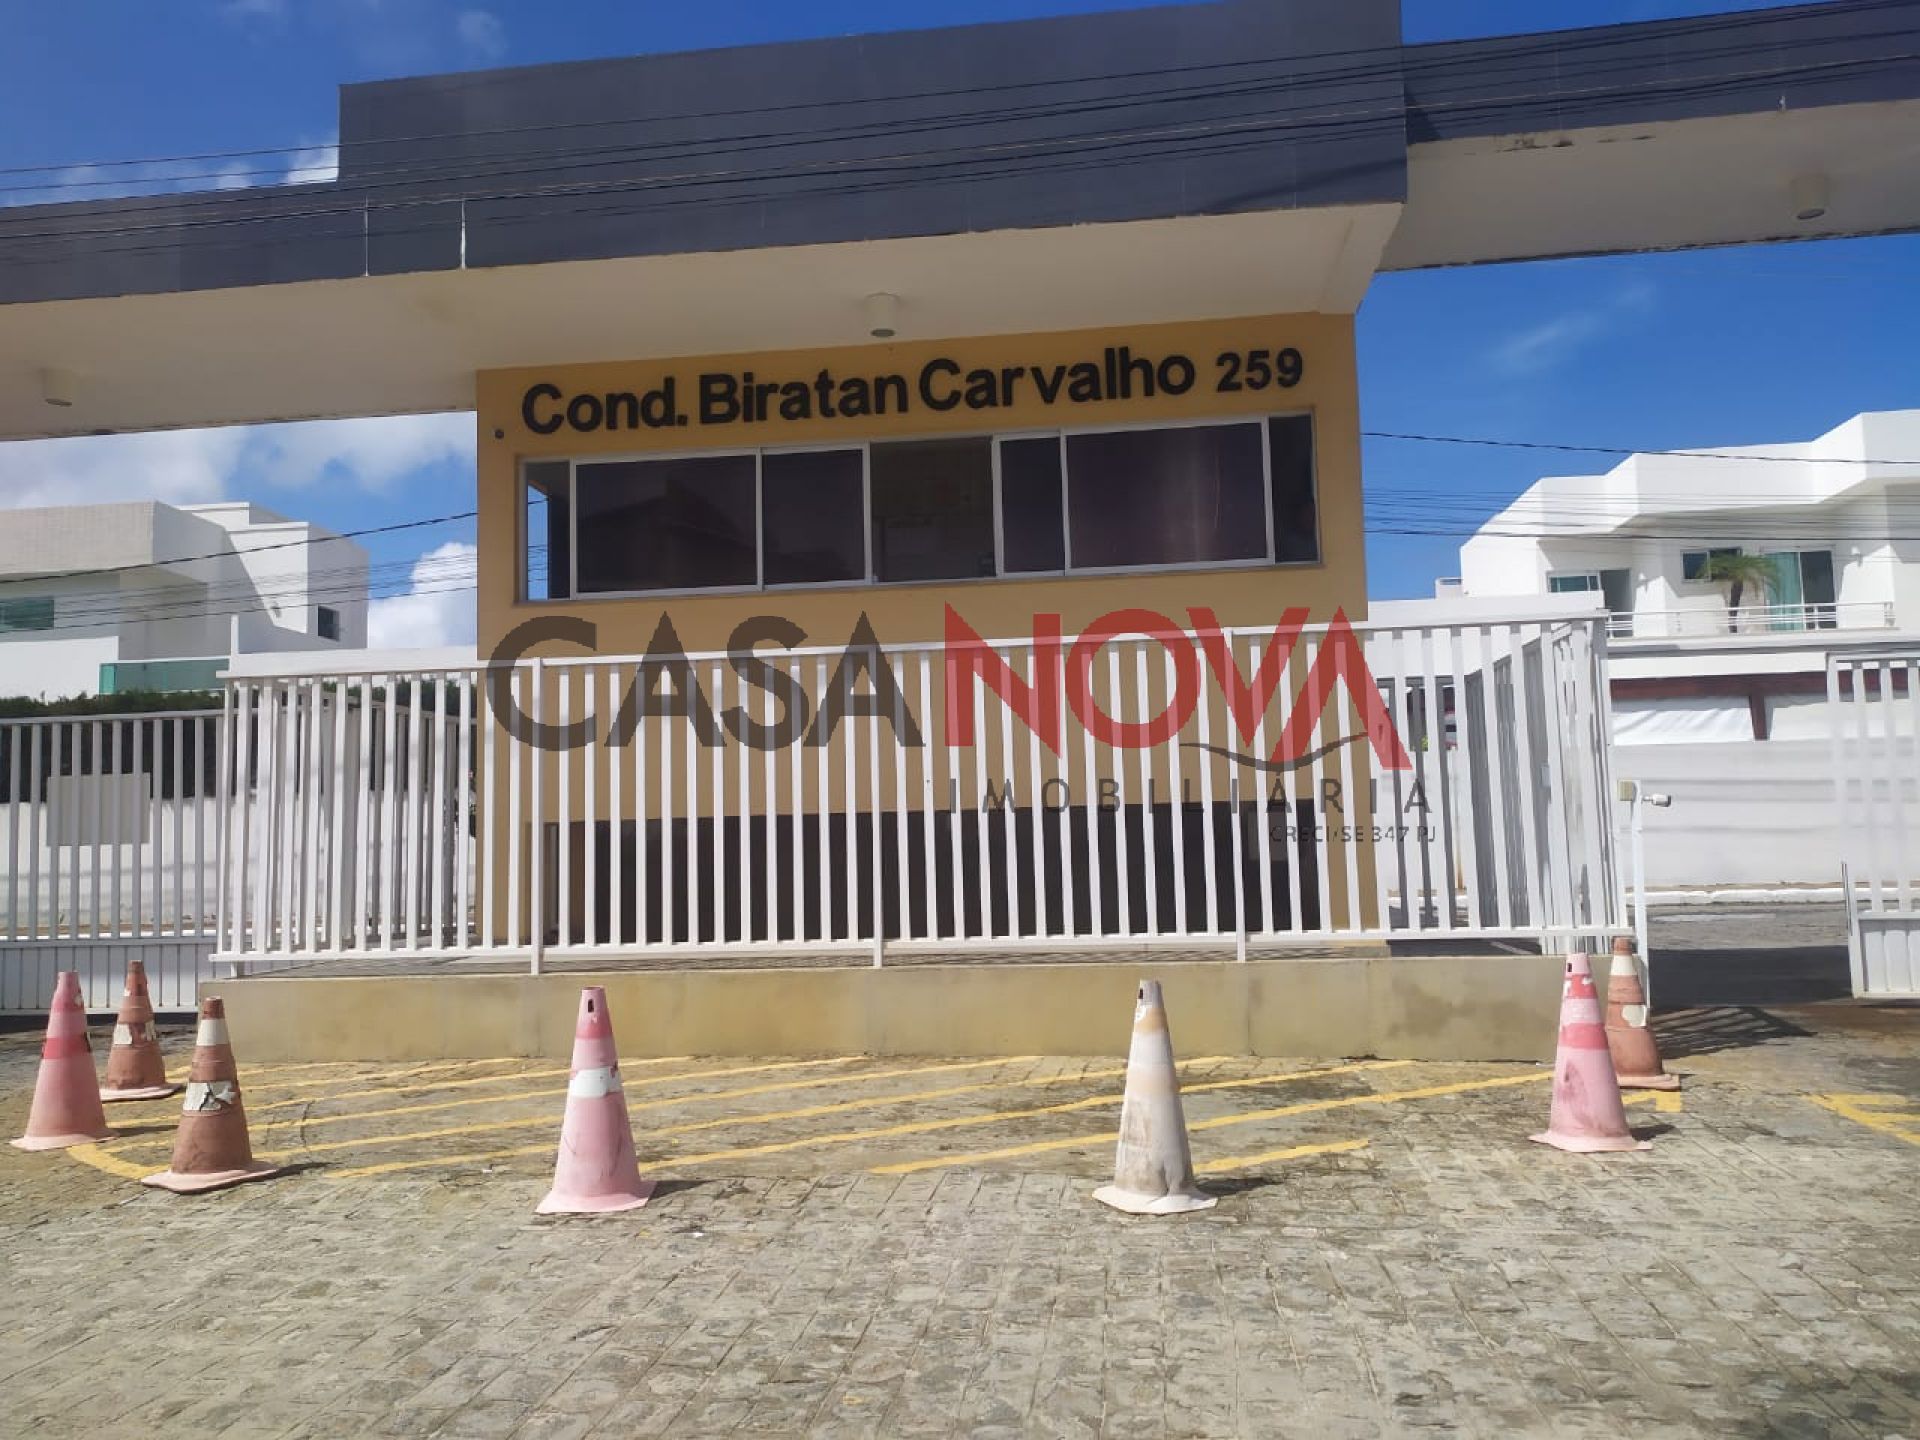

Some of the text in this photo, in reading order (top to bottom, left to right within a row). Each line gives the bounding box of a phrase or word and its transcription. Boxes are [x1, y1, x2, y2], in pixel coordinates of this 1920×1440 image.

[521, 346, 1304, 434] Cond. Biratan Carvalho 259
